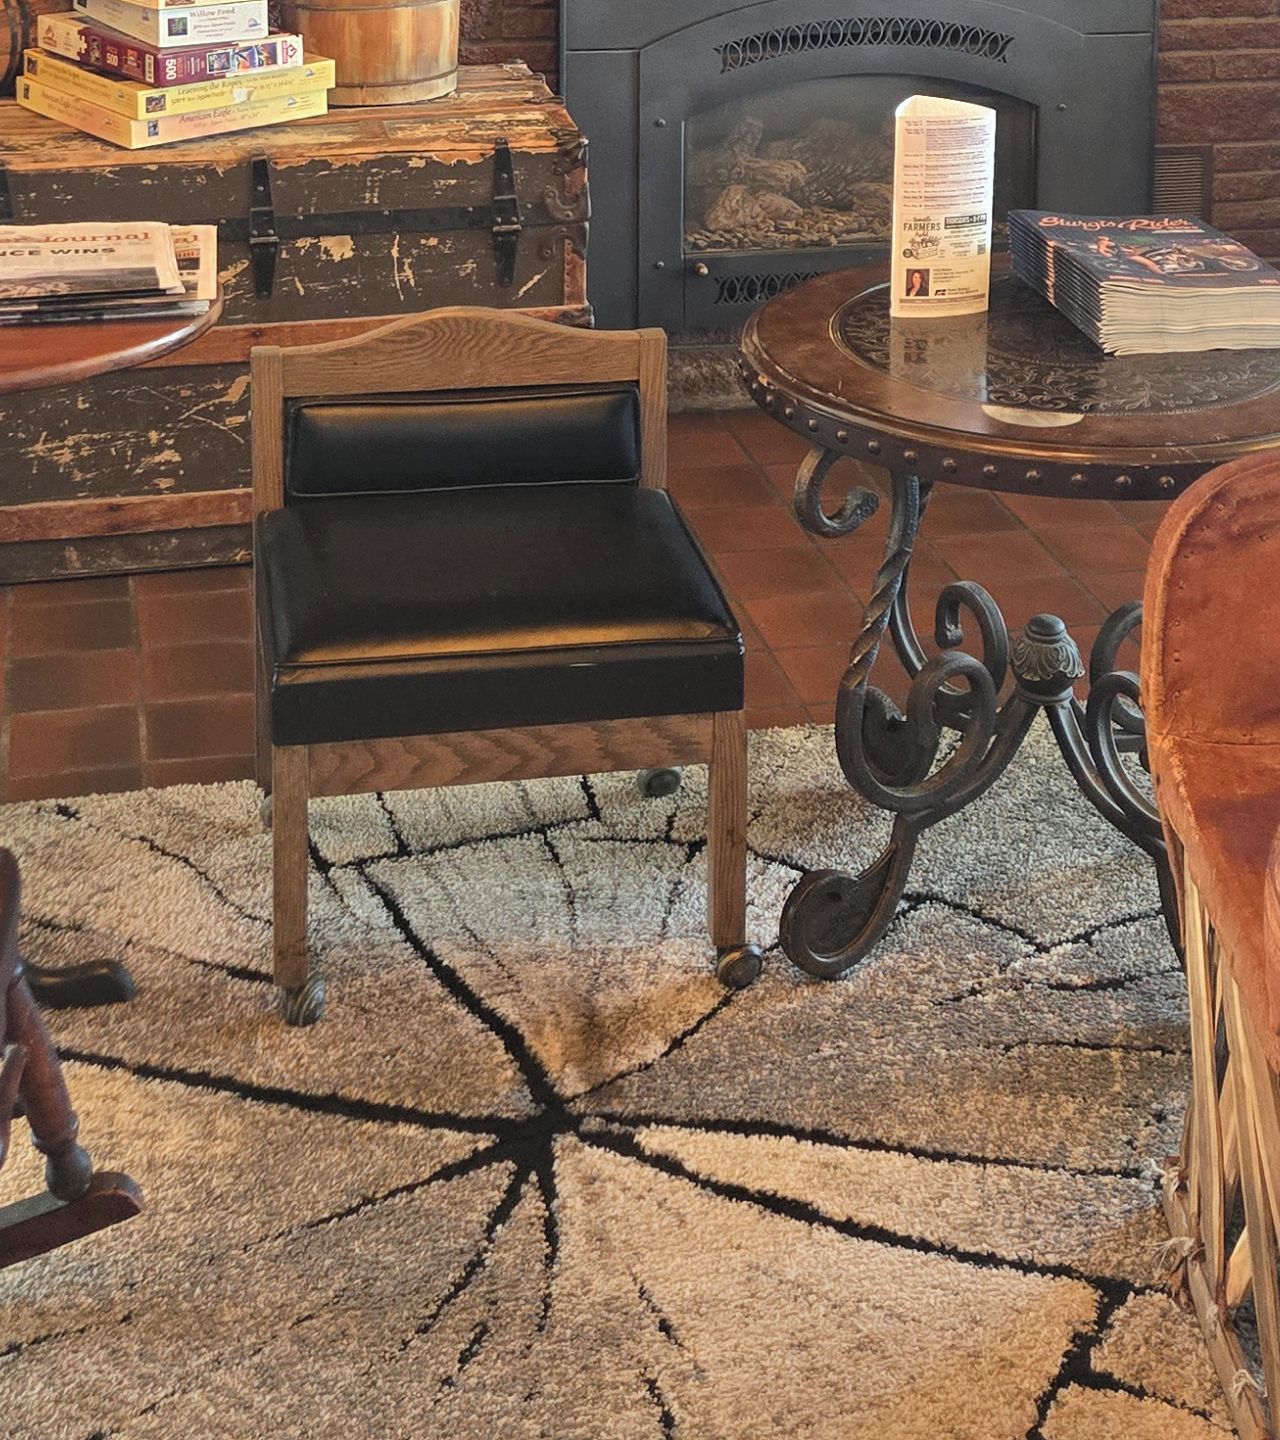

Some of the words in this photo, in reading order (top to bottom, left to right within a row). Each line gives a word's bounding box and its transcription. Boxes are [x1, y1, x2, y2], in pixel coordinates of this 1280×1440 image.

[189, 9, 216, 18] Willow
[217, 7, 236, 16] Pond
[177, 83, 208, 96] Learning
[209, 81, 220, 90] the
[179, 111, 213, 124] American
[213, 109, 232, 119] Eagle
[903, 223, 942, 232] FARMERS
[1038, 216, 1116, 231] Sturgis
[1117, 217, 1192, 231] Rider
[41, 231, 153, 244] Journal
[50, 247, 116, 256] WINS
